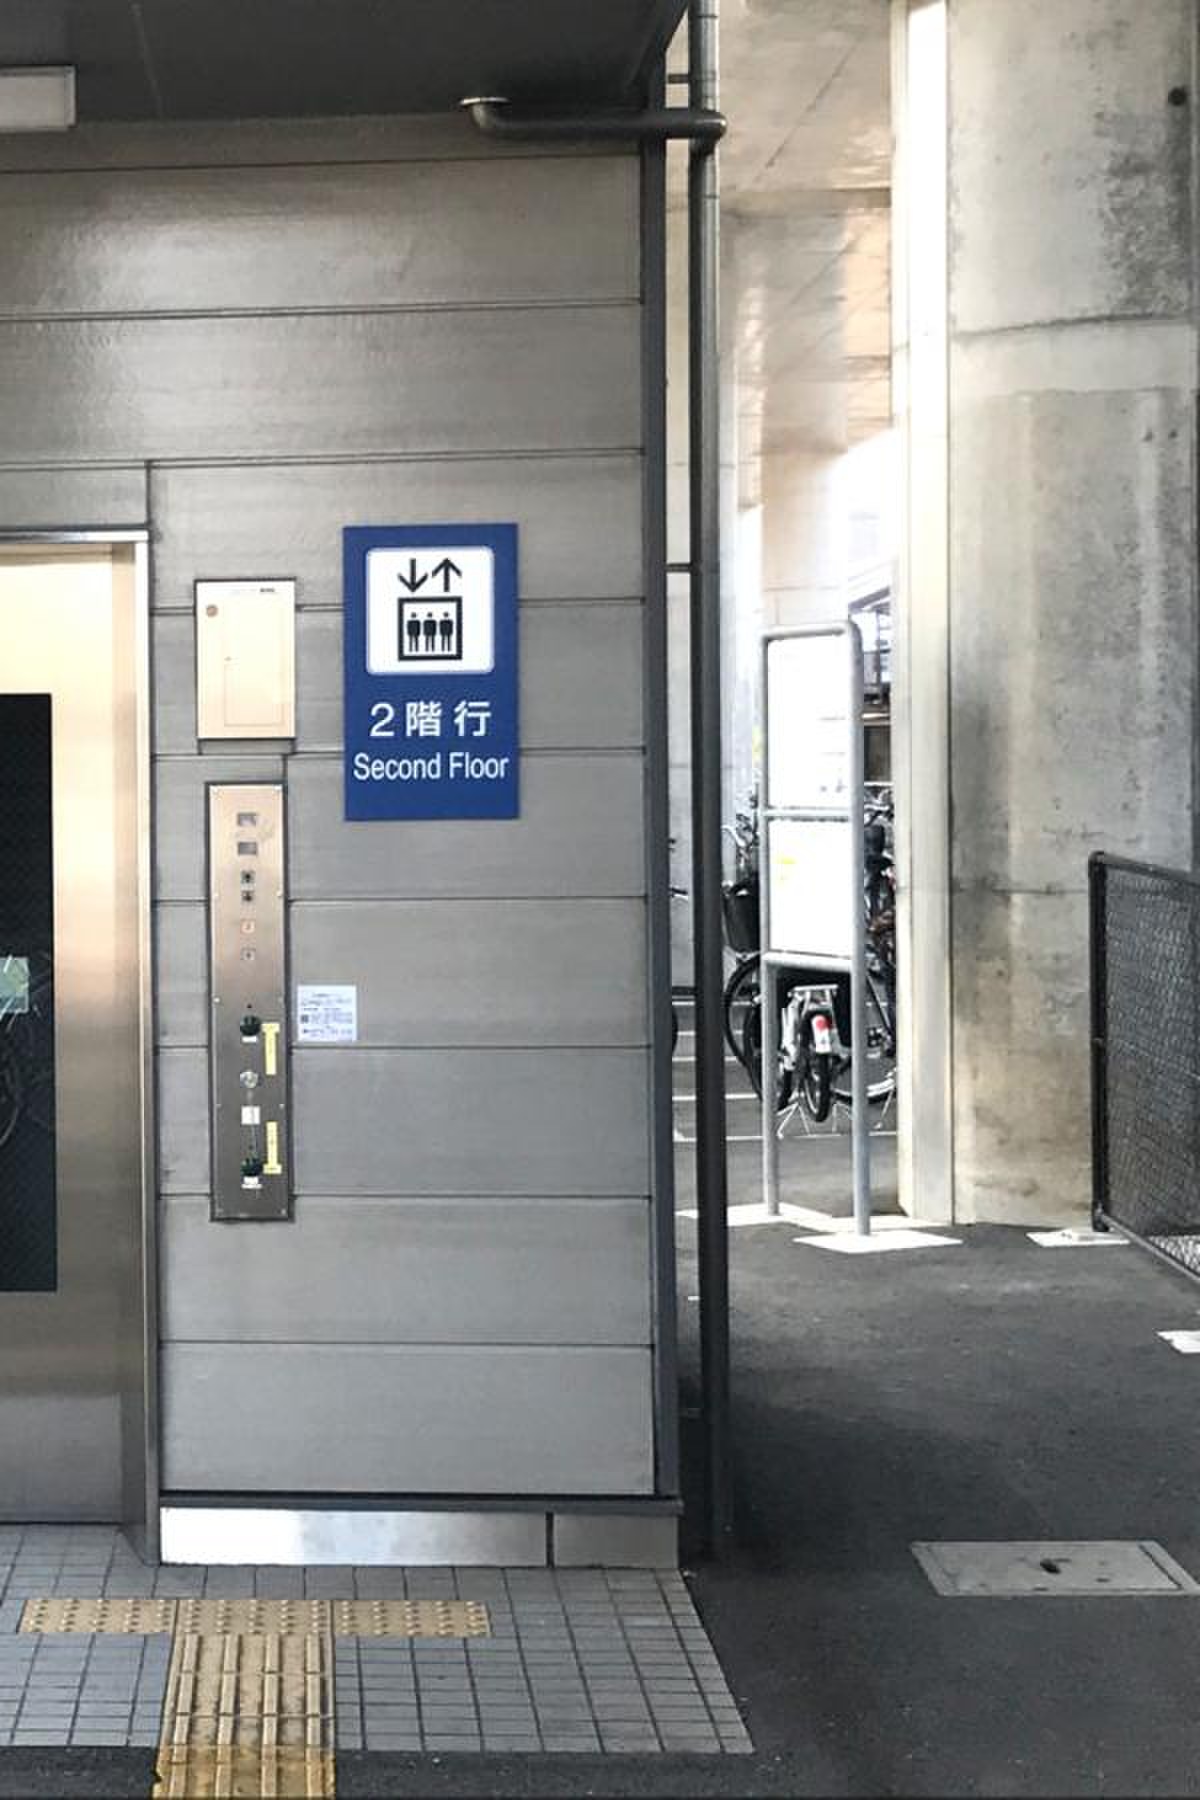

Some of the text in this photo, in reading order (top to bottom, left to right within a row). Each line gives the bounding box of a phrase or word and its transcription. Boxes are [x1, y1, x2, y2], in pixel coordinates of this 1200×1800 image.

[369, 701, 491, 737] 2階行
[353, 752, 509, 780] Second Floor
